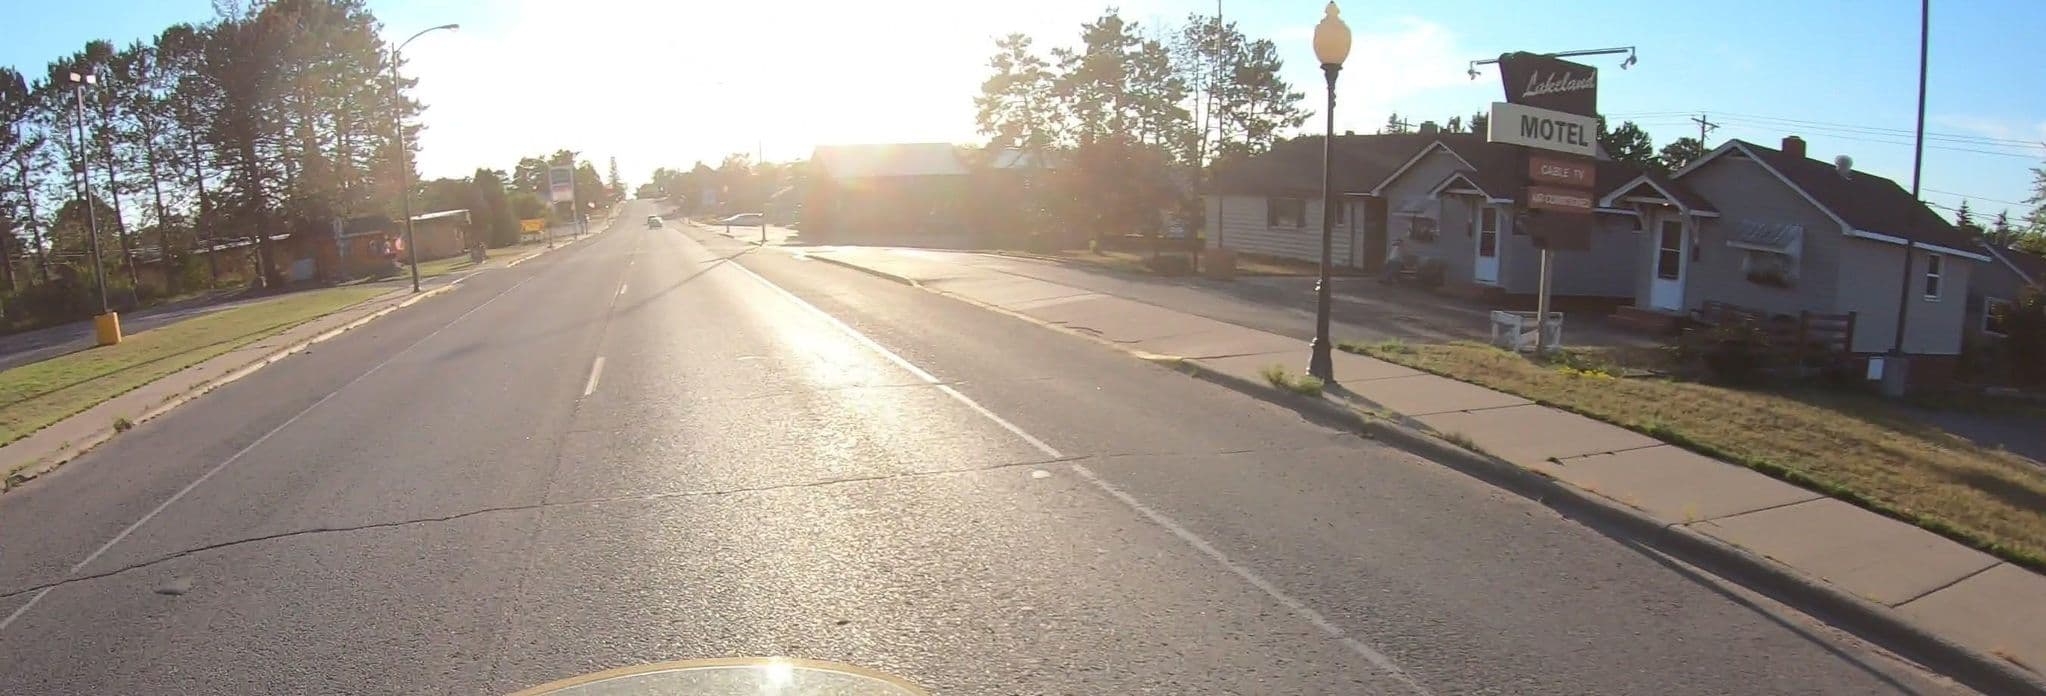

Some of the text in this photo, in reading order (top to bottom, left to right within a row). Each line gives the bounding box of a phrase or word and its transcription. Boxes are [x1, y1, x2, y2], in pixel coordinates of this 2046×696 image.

[1523, 70, 1596, 97] Lakeland
[1520, 114, 1588, 147] MOTEL
[1541, 164, 1585, 180] CABLE TV
